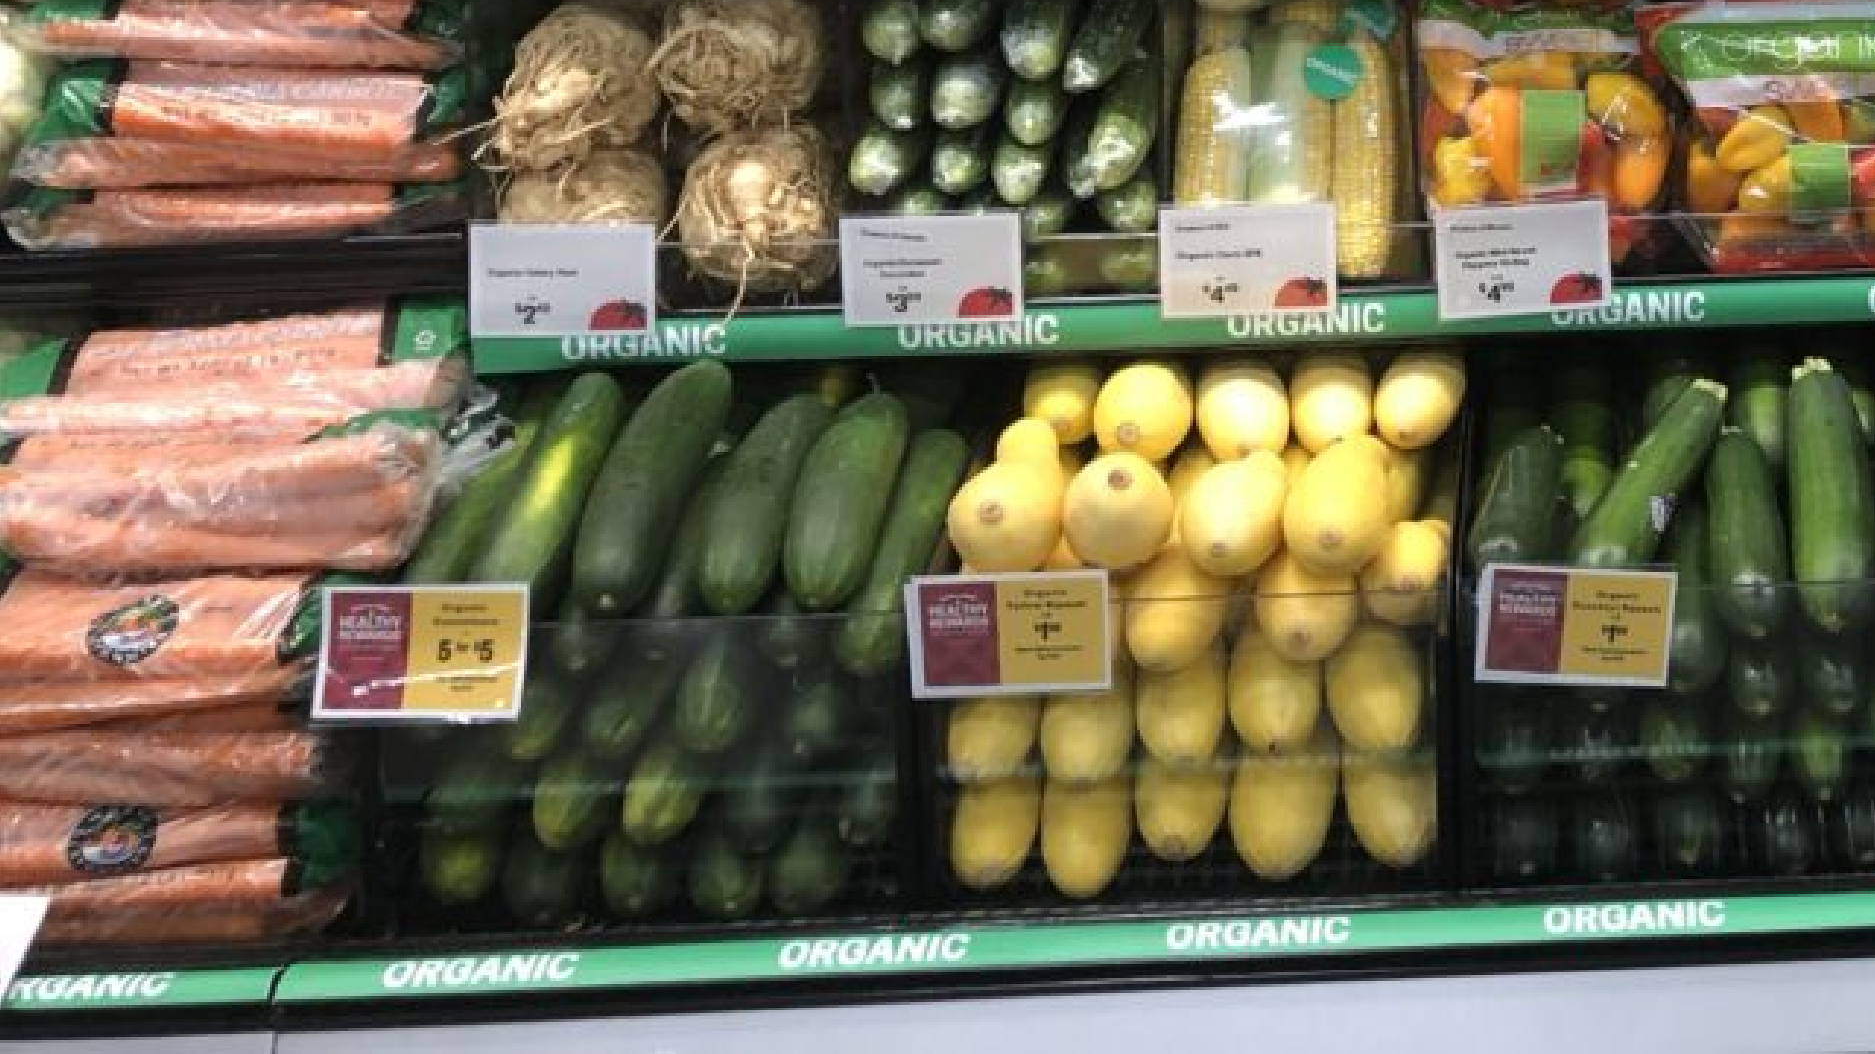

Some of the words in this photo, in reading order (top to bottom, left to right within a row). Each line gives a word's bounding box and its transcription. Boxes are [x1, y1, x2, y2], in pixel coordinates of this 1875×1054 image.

[898, 315, 1059, 348] ORGANIC
[1225, 302, 1383, 336] ORGANIC
[561, 324, 727, 360] ORGANIC
[436, 638, 453, 662] 5
[1166, 917, 1352, 951] ORGANIC
[1543, 901, 1726, 933] ORGANIC
[778, 934, 970, 969] ORGANIC
[10, 973, 176, 1002] RGANIC
[383, 954, 580, 989] ORGANIC
